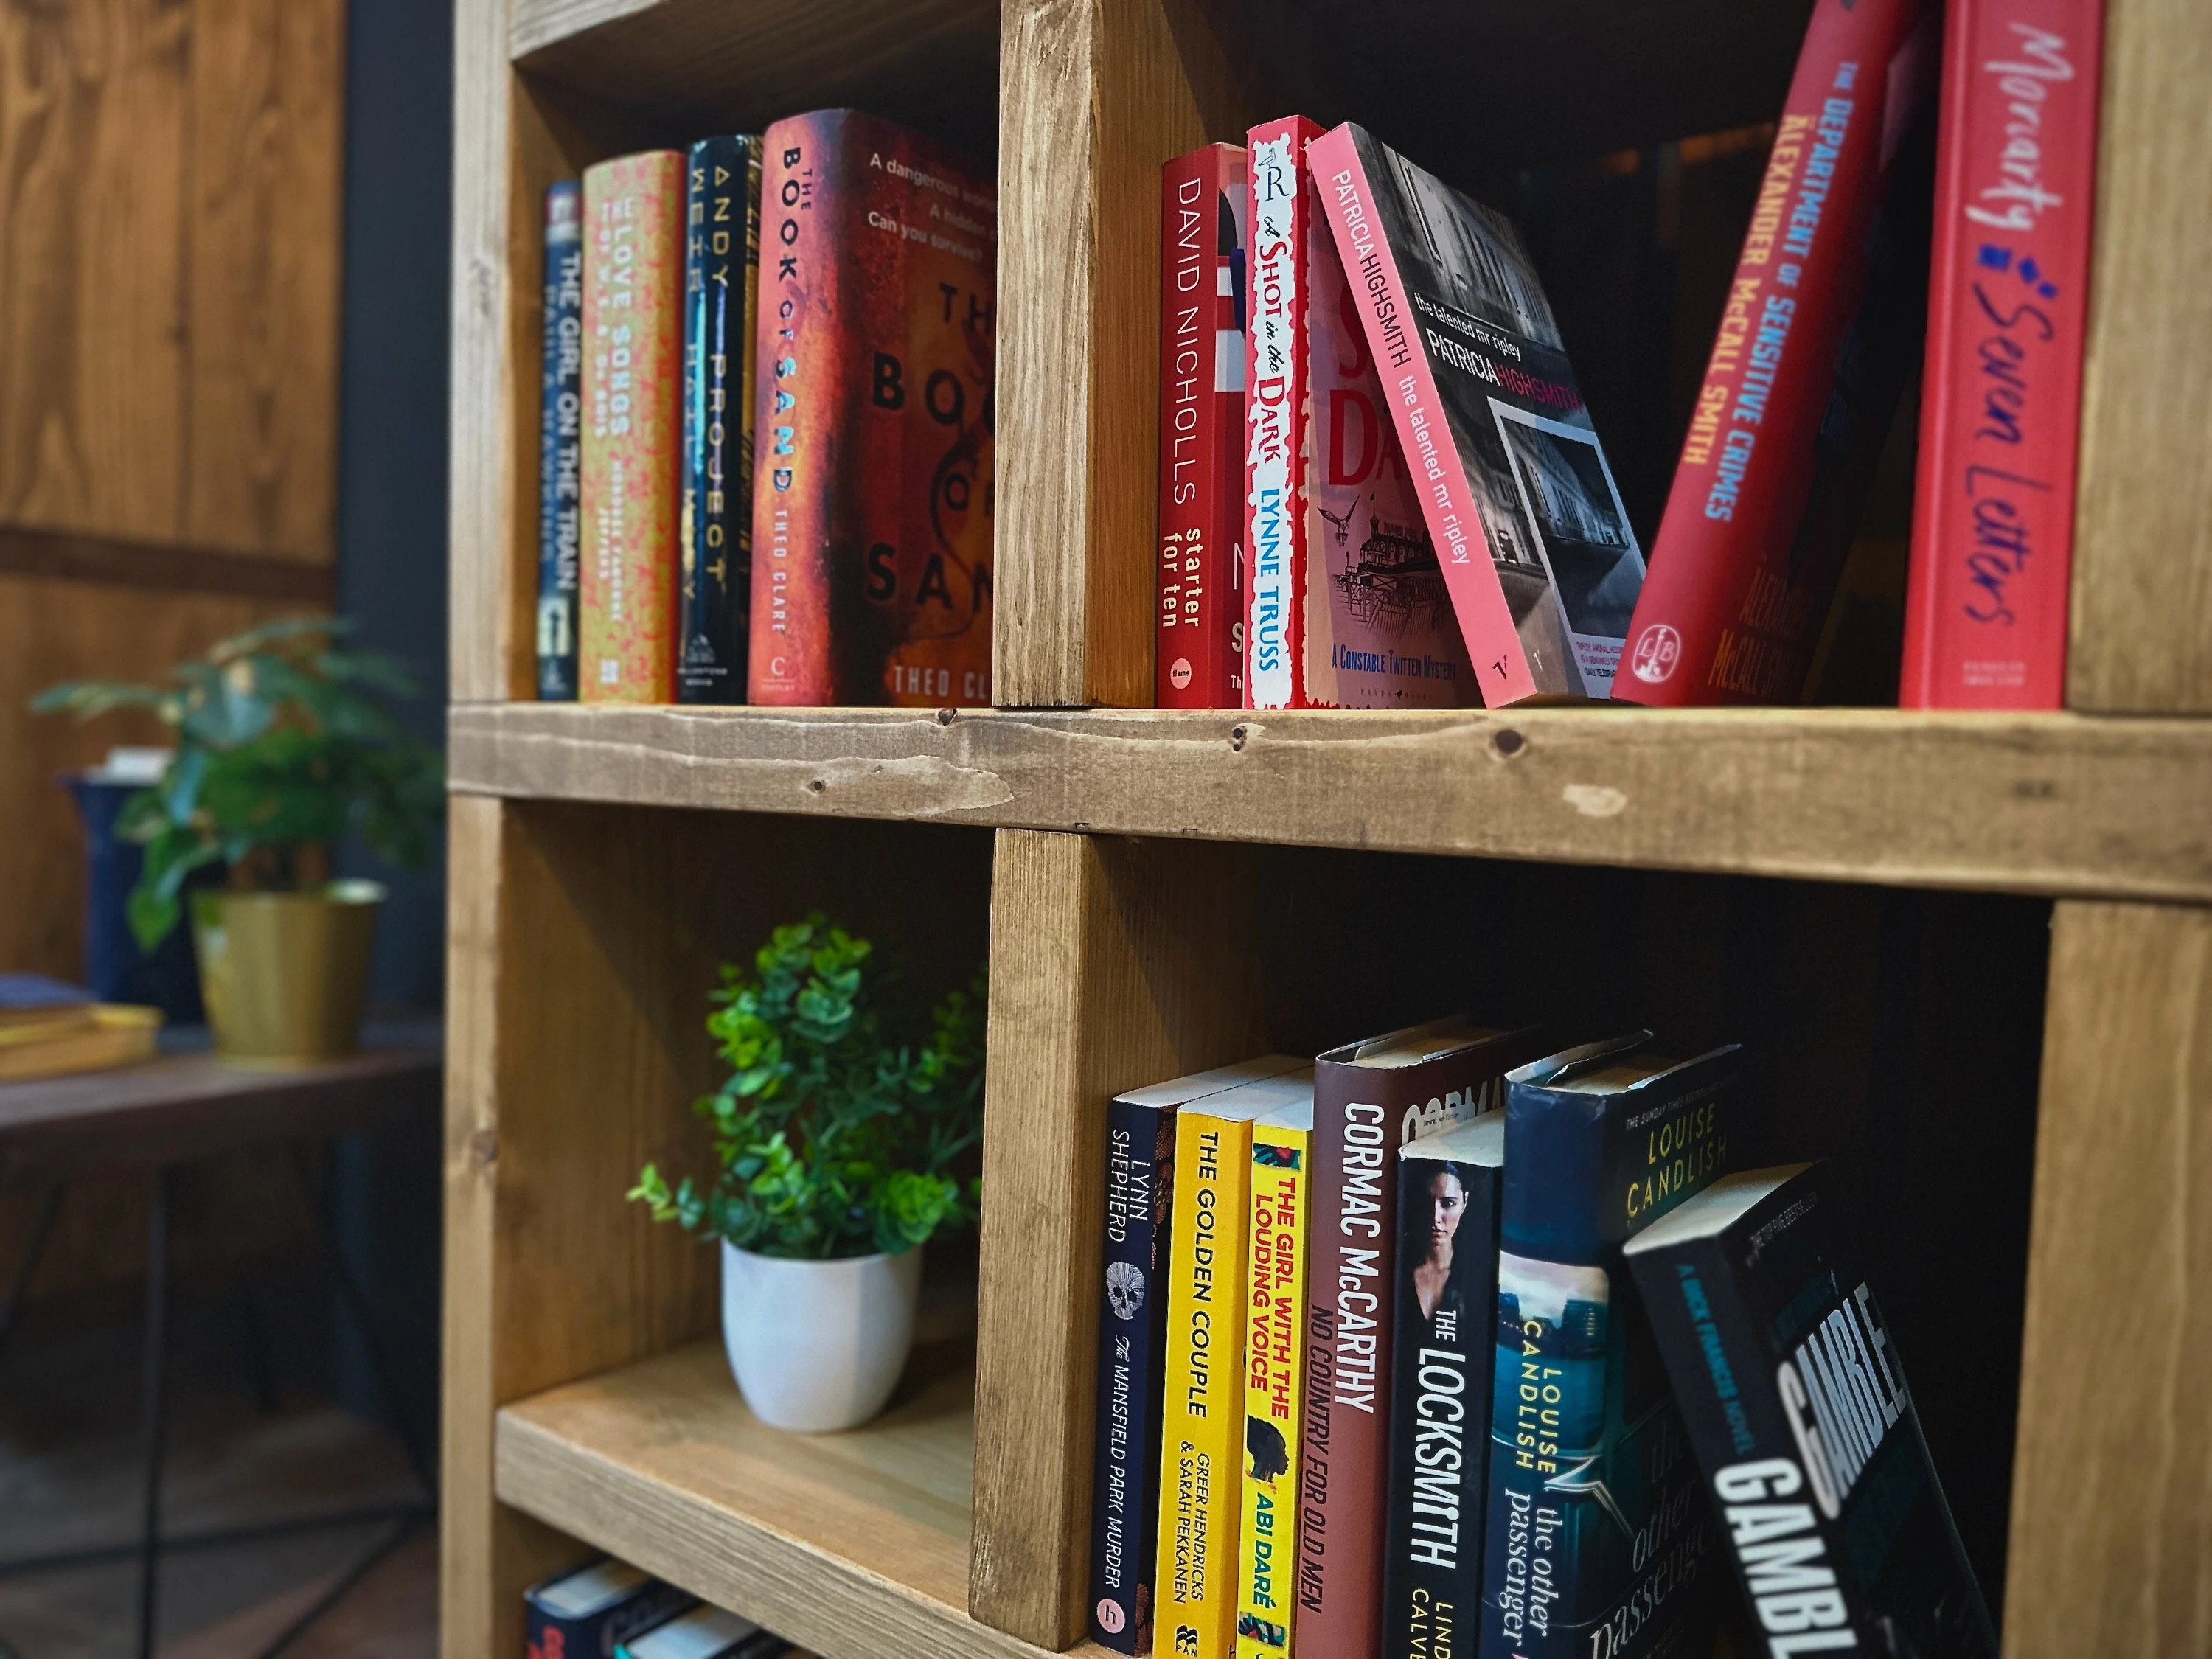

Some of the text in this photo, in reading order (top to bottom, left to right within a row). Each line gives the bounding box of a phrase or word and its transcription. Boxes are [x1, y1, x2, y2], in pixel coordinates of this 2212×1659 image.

[689, 168, 705, 293] WEIR
[712, 166, 730, 287] ANDY
[801, 168, 813, 210] THE
[868, 211, 897, 234] Can
[900, 223, 928, 245] you
[870, 153, 882, 170] A
[886, 159, 959, 198] dangerous
[929, 204, 941, 220] A
[1782, 97, 1854, 258] DEPARTMENT
[611, 226, 633, 435] LOVE SONGS
[773, 147, 801, 492] BOOK OF SAND
[939, 282, 994, 333] TH
[1259, 241, 1287, 318] SHOT
[1266, 321, 1276, 341] in
[1414, 293, 1521, 362] the talented mr ripley
[1683, 116, 1809, 465] ALEXANDER McCALL SMITH
[1777, 262, 1801, 288] OF
[1174, 178, 1201, 504] DAVID NICHOLLS
[1267, 344, 1285, 374] the
[1732, 294, 1796, 426] SENSITIVE
[1973, 283, 2054, 445] Seven
[555, 251, 581, 590] THE GIRL ON THE TRAIN
[706, 354, 726, 583] PROJECT
[1257, 376, 1285, 464] DARK
[1399, 375, 1417, 406] the
[1409, 407, 1447, 481] talented
[1433, 483, 1453, 509] mr
[1443, 515, 1470, 565] ripley
[1705, 428, 1755, 523] CRIMES
[681, 489, 695, 599] MY
[772, 510, 787, 632] THEO CLARE
[1163, 532, 1183, 627] for ten
[1184, 528, 1203, 627] starter
[1259, 488, 1280, 672] LYNNE TRUSS
[1965, 463, 2053, 626] Letters
[894, 663, 950, 699] THEO
[1332, 643, 1457, 681] A CONSTABLE TWITTEN MYSTERY
[1626, 1115, 1638, 1131] THE
[1641, 1104, 1666, 1124] SUNDAY
[1627, 1133, 1728, 1218] CANDLISH
[1647, 1102, 1716, 1165] LOUISE
[1109, 1129, 1130, 1242] SHEPHERD
[1130, 1160, 1150, 1221] LYNN
[1187, 1131, 1219, 1419] THE GOLDEN COUPLE
[1251, 1194, 1273, 1393] LOUDING VOICE
[1271, 1178, 1295, 1420] THE GIRL WITH THE
[1335, 1102, 1385, 1414] CORMAC McCARTHY
[1410, 1310, 1466, 1570] THE LOCKSMITH
[1514, 1320, 1542, 1470] CANDLISH
[1537, 1368, 1562, 1474] LOUISE
[1776, 1279, 1909, 1523] GAMBLE
[1105, 1335, 1130, 1588] The MANSFIELD PARK MURDER
[1299, 1304, 1333, 1614] NO COUNTRY FOR OLD MEN
[1173, 1441, 1194, 1604] & SARAH PEKKANEN
[1190, 1453, 1210, 1602] GREER HENDRICKS
[1253, 1492, 1276, 1609] ABI DARÉ
[1498, 1487, 1531, 1646] passenger
[1528, 1506, 1562, 1637] the other
[1175, 1644, 1198, 1659] PAN
